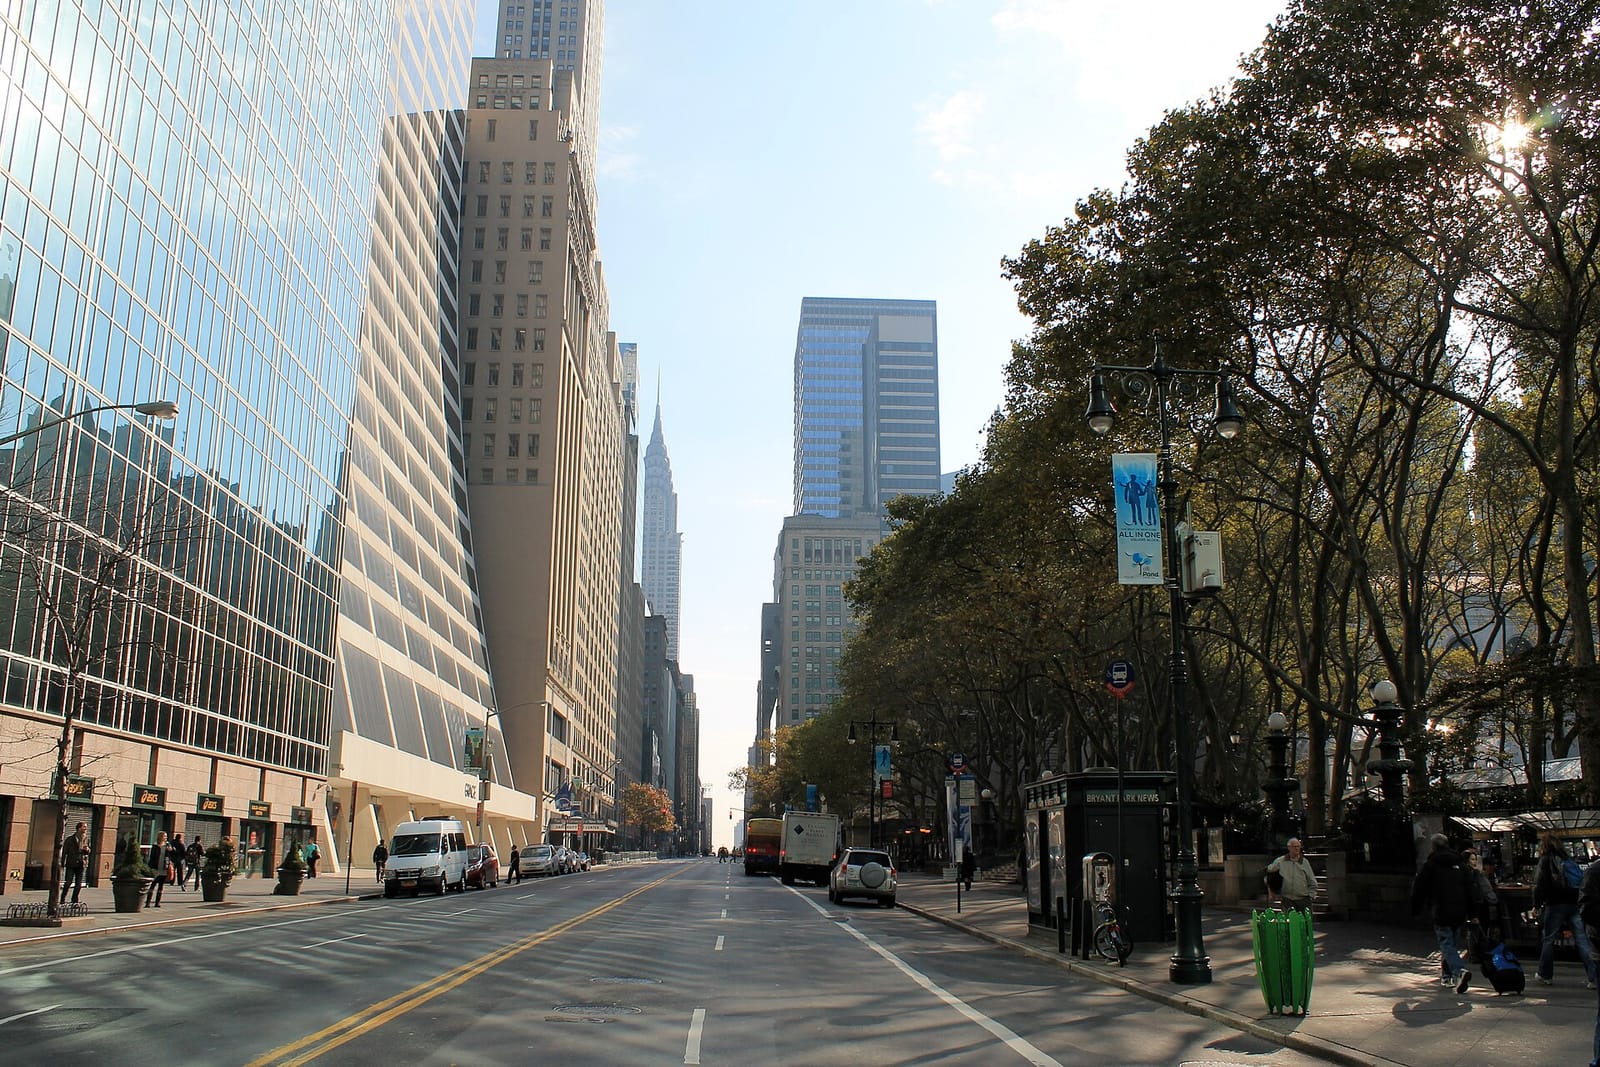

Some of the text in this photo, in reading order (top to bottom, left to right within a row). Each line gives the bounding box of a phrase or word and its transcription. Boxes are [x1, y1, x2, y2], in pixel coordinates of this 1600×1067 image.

[1144, 531, 1161, 539] ONE
[1086, 793, 1116, 803] BRYANT
[1137, 793, 1160, 803] NEWS
